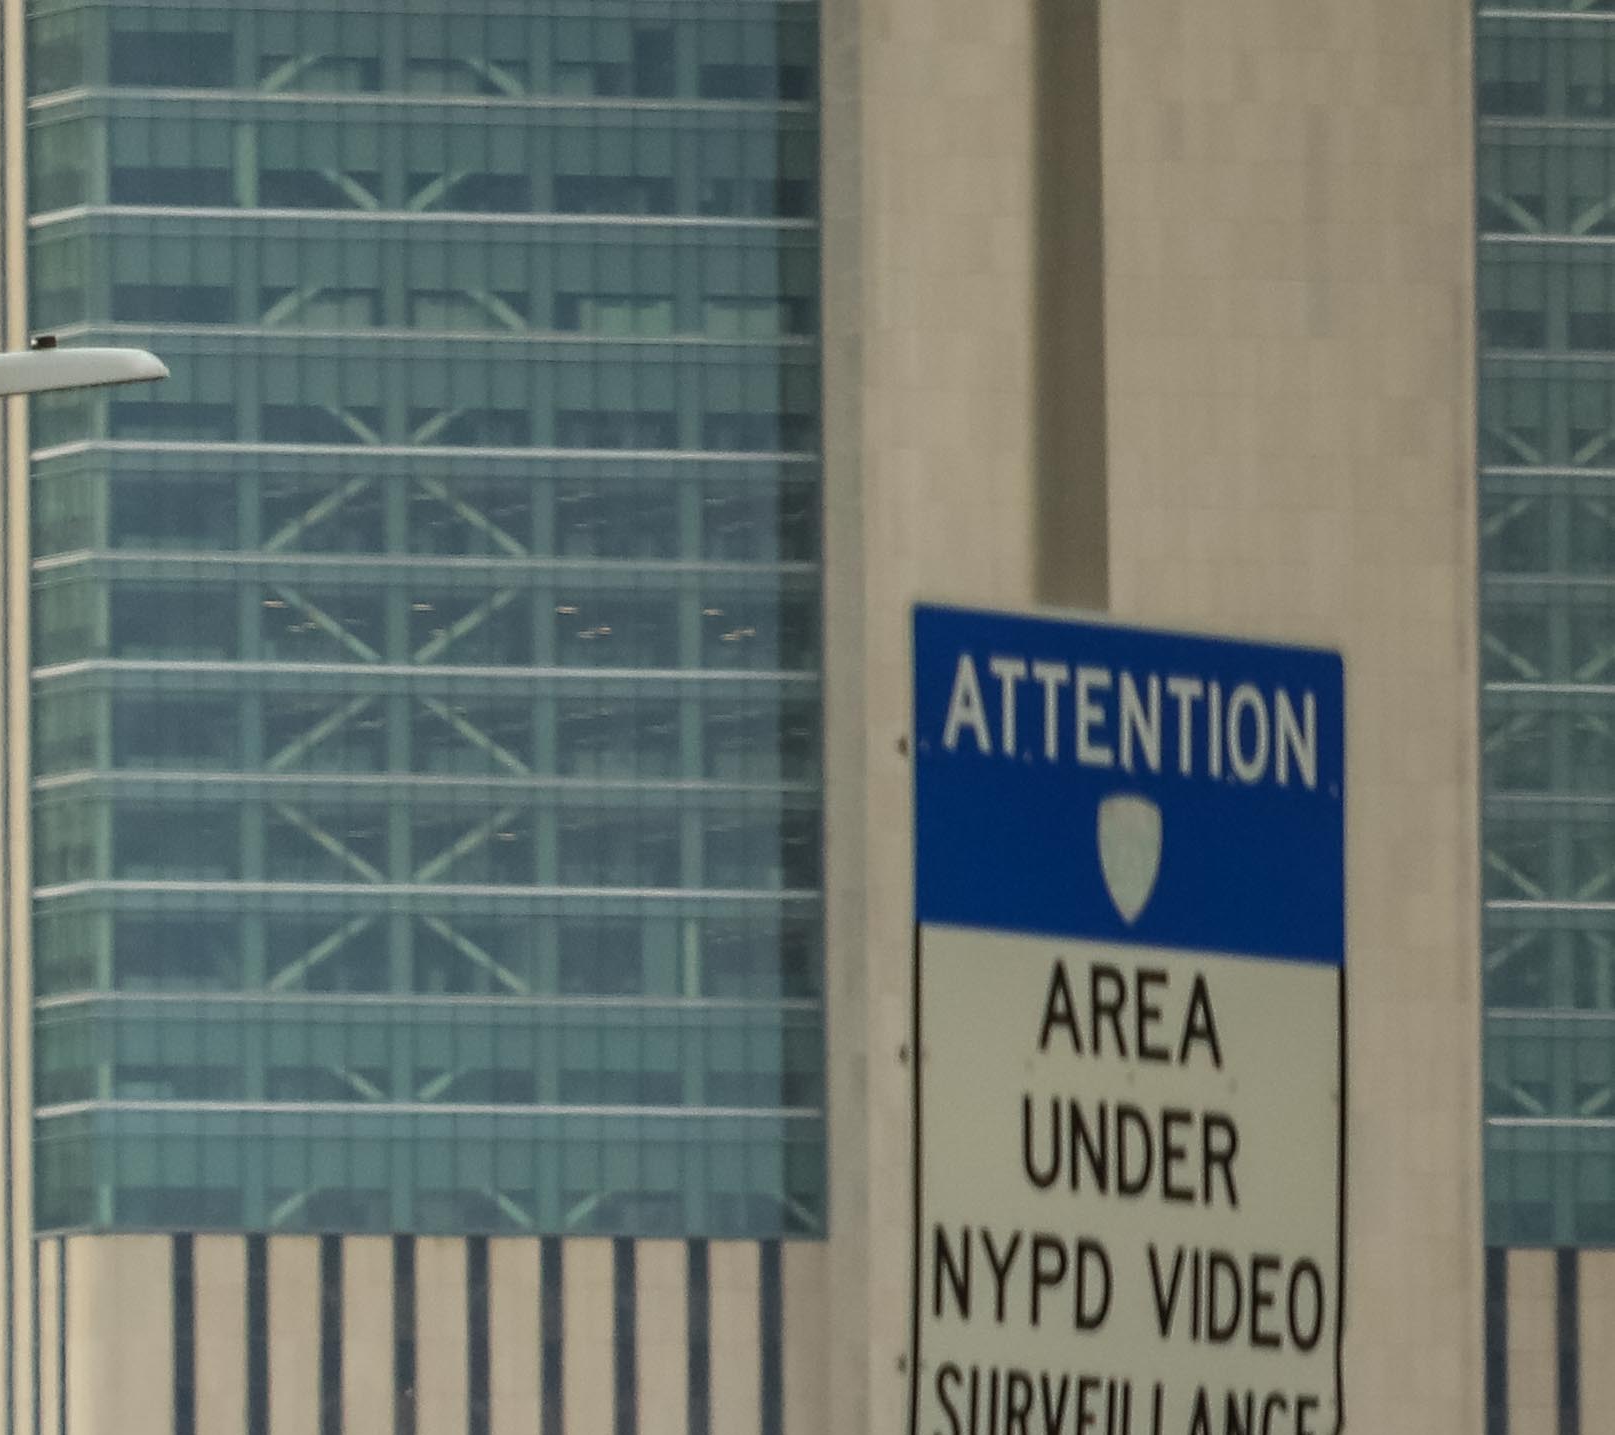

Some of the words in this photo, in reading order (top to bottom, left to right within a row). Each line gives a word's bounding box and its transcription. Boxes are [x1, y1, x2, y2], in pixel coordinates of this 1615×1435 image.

[943, 655, 1317, 788] ATTENTION
[1037, 961, 1222, 1068] AREA
[1025, 1094, 1240, 1207] UNDER
[932, 1224, 1112, 1332] NYPD
[1147, 1243, 1325, 1352] VIDEO
